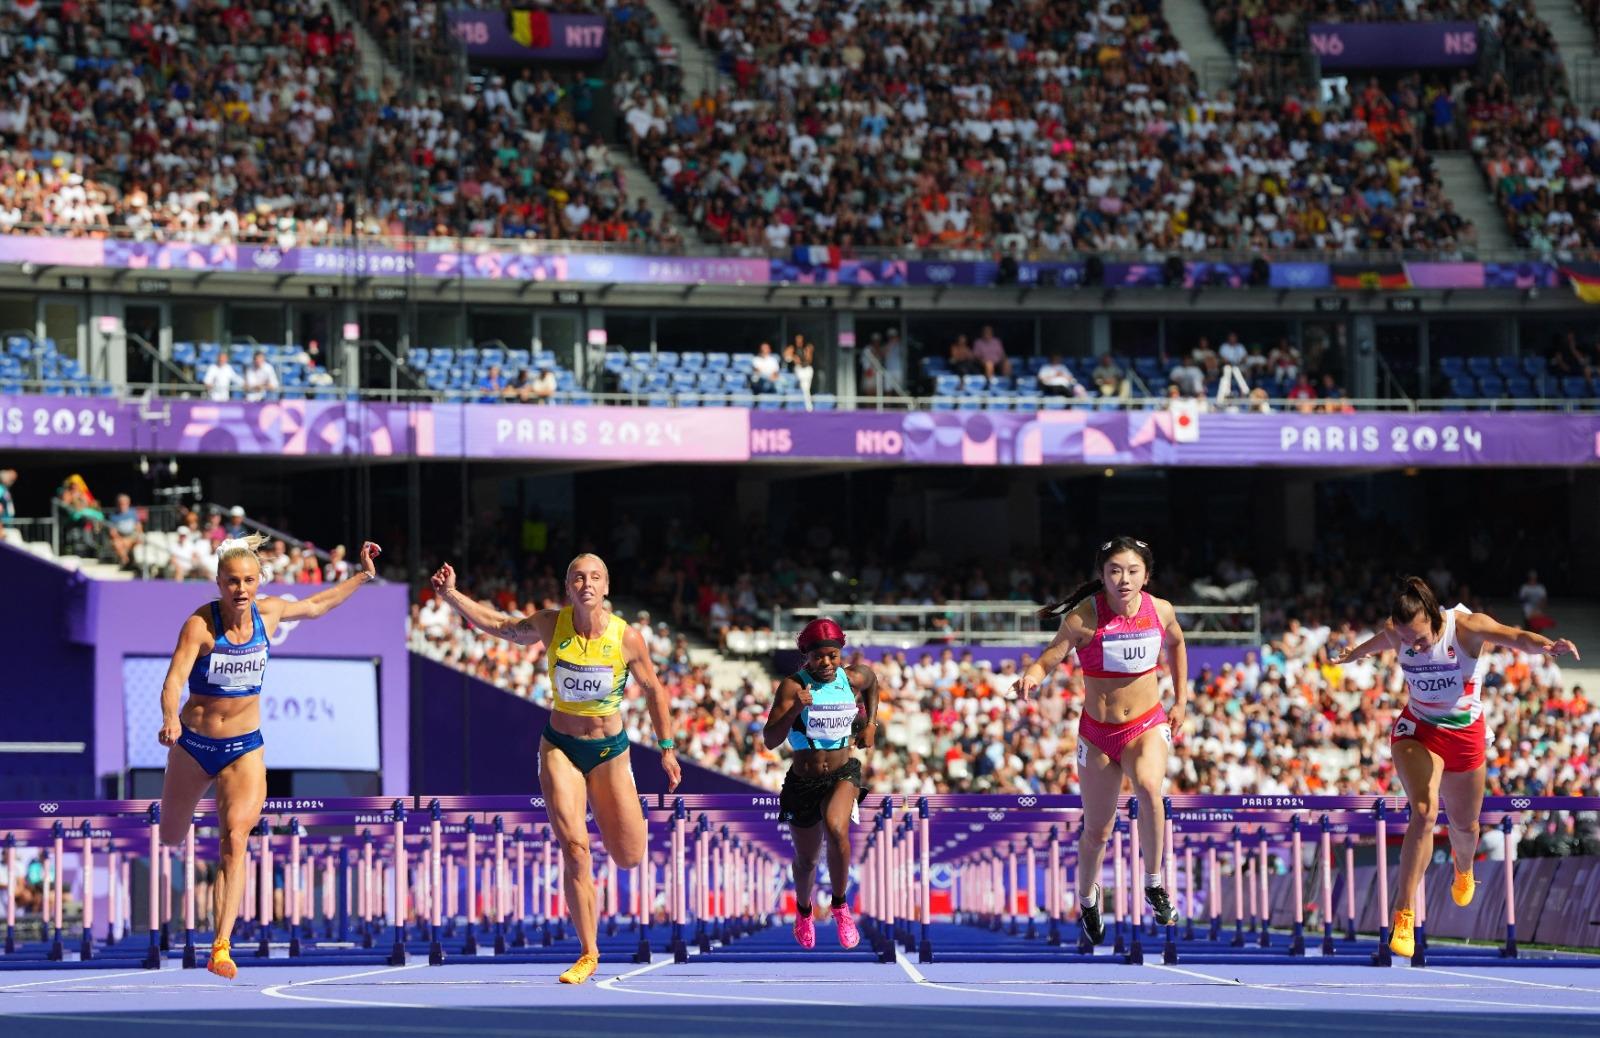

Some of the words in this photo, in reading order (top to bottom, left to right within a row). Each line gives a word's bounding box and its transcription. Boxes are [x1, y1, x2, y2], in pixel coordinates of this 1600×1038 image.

[565, 26, 605, 47] N17
[1310, 33, 1344, 55] N6
[1444, 32, 1477, 54] N5
[33, 408, 114, 437] 2024
[599, 420, 682, 446] 2024
[751, 429, 792, 453] N15
[856, 430, 903, 454] N10
[1391, 426, 1482, 452] 2024
[1123, 646, 1146, 660] WU
[213, 658, 266, 674] HARALA
[563, 677, 602, 692] CLAY
[264, 696, 336, 721] 2024
[186, 739, 212, 751] CRAFT
[296, 800, 325, 809] 2024
[1276, 798, 1304, 806] 2024
[1209, 812, 1234, 820] 2024
